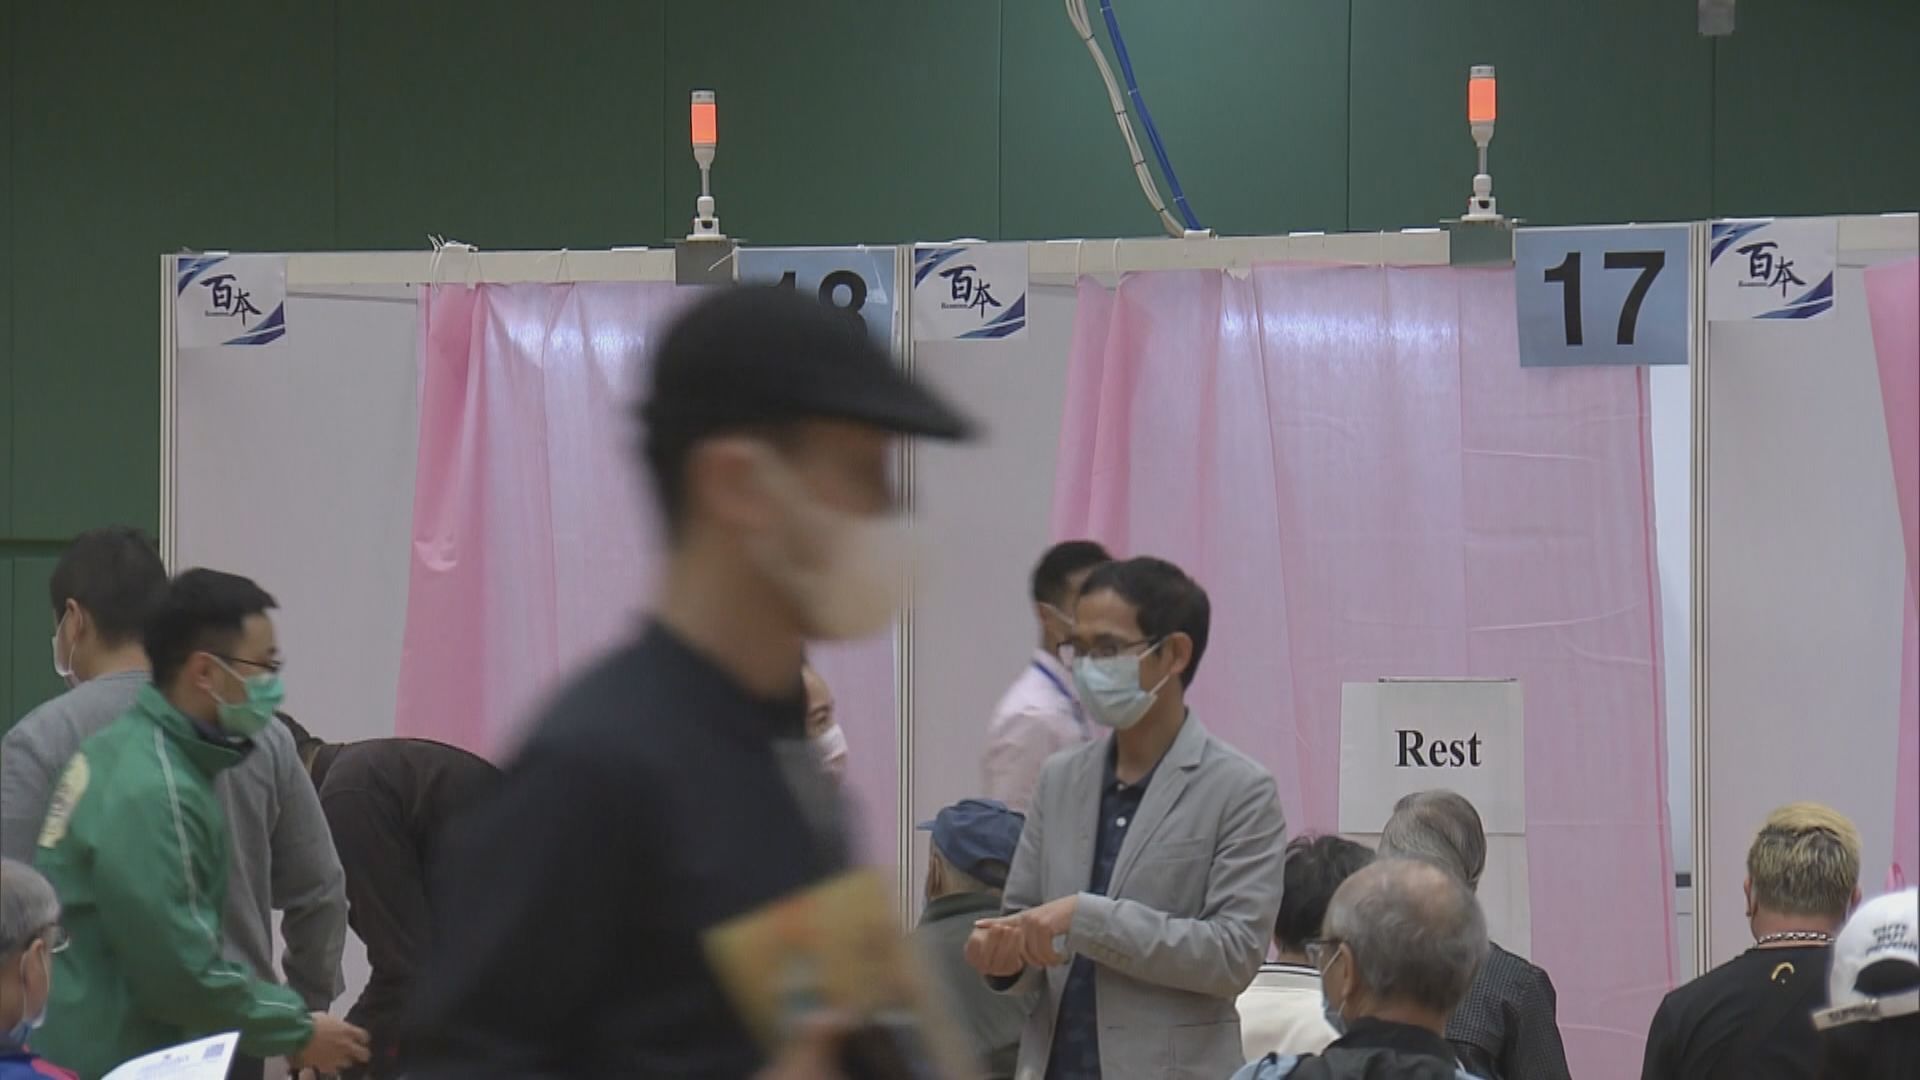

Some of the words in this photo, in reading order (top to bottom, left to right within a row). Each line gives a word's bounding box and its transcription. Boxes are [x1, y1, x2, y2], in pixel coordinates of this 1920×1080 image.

[939, 265, 1002, 318] 百本
[1736, 242, 1806, 298] 百本
[200, 274, 262, 326] 百本
[1544, 252, 1665, 345] 17
[1395, 729, 1482, 767] Rest
